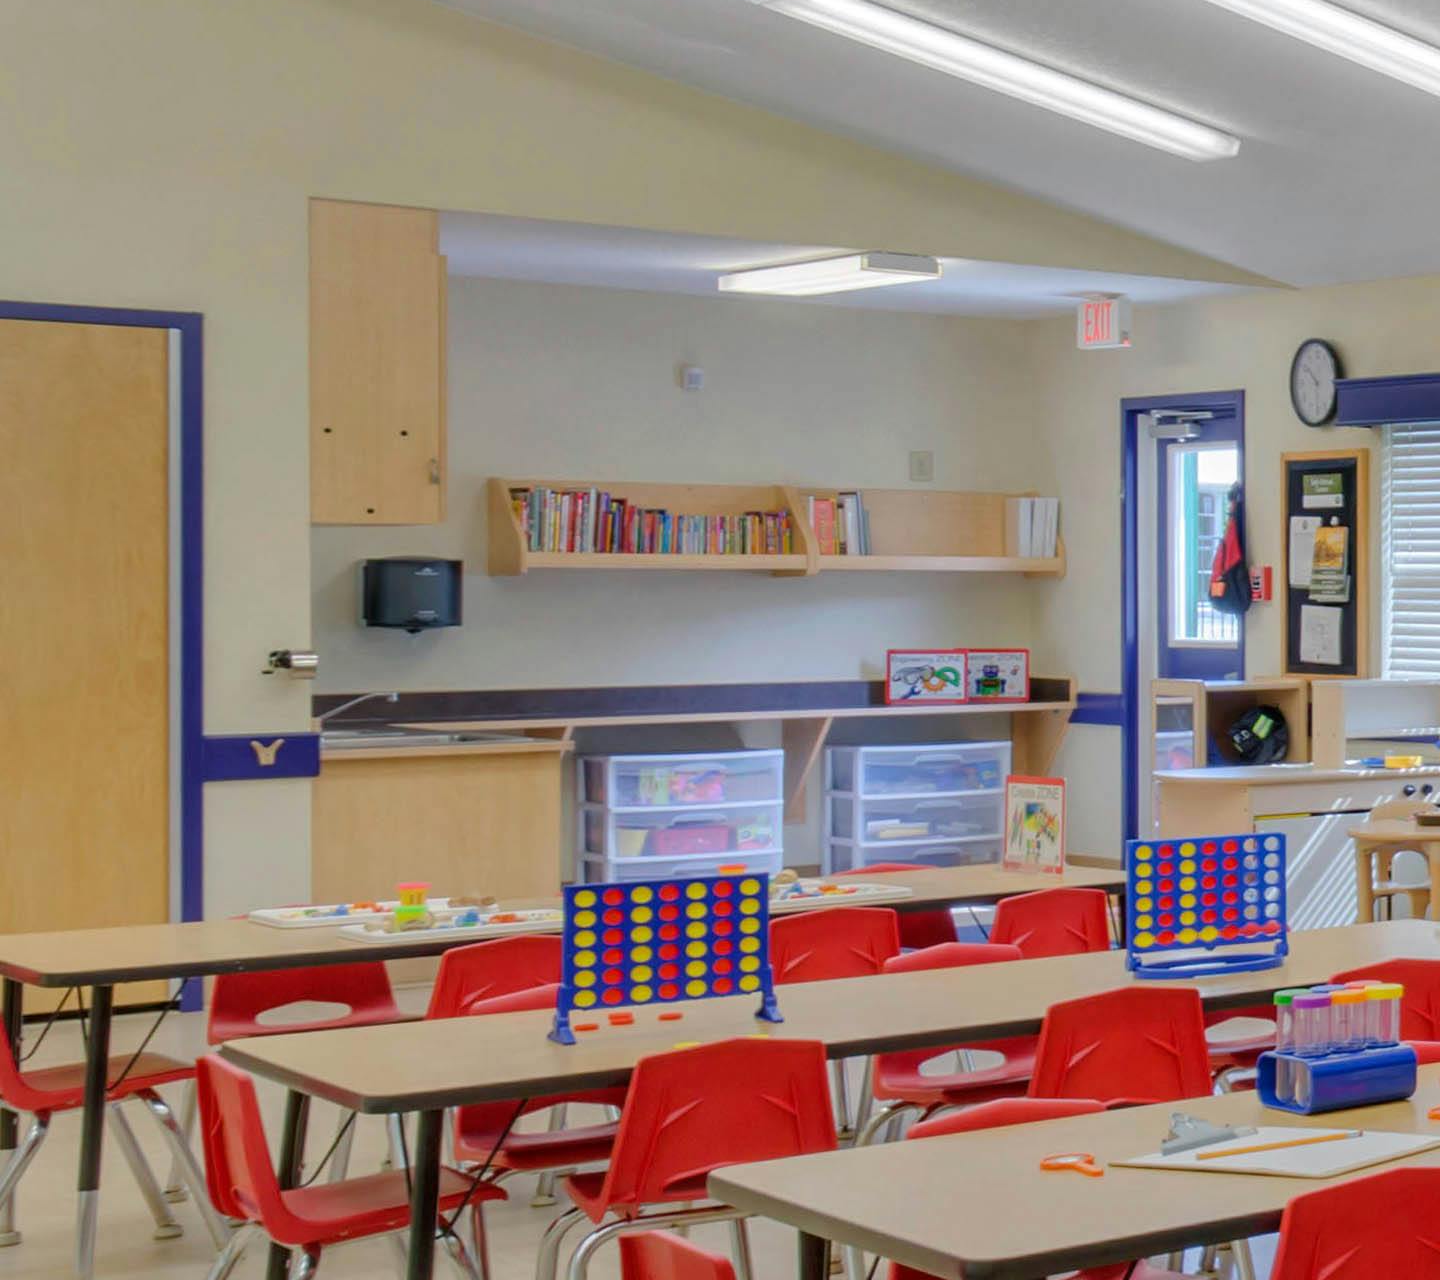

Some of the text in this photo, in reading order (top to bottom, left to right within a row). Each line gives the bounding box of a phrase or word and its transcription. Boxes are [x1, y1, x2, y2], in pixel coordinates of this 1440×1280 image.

[1083, 302, 1113, 343] EXIT
[936, 653, 963, 663] ZONE
[1037, 785, 1061, 801] ZONE
